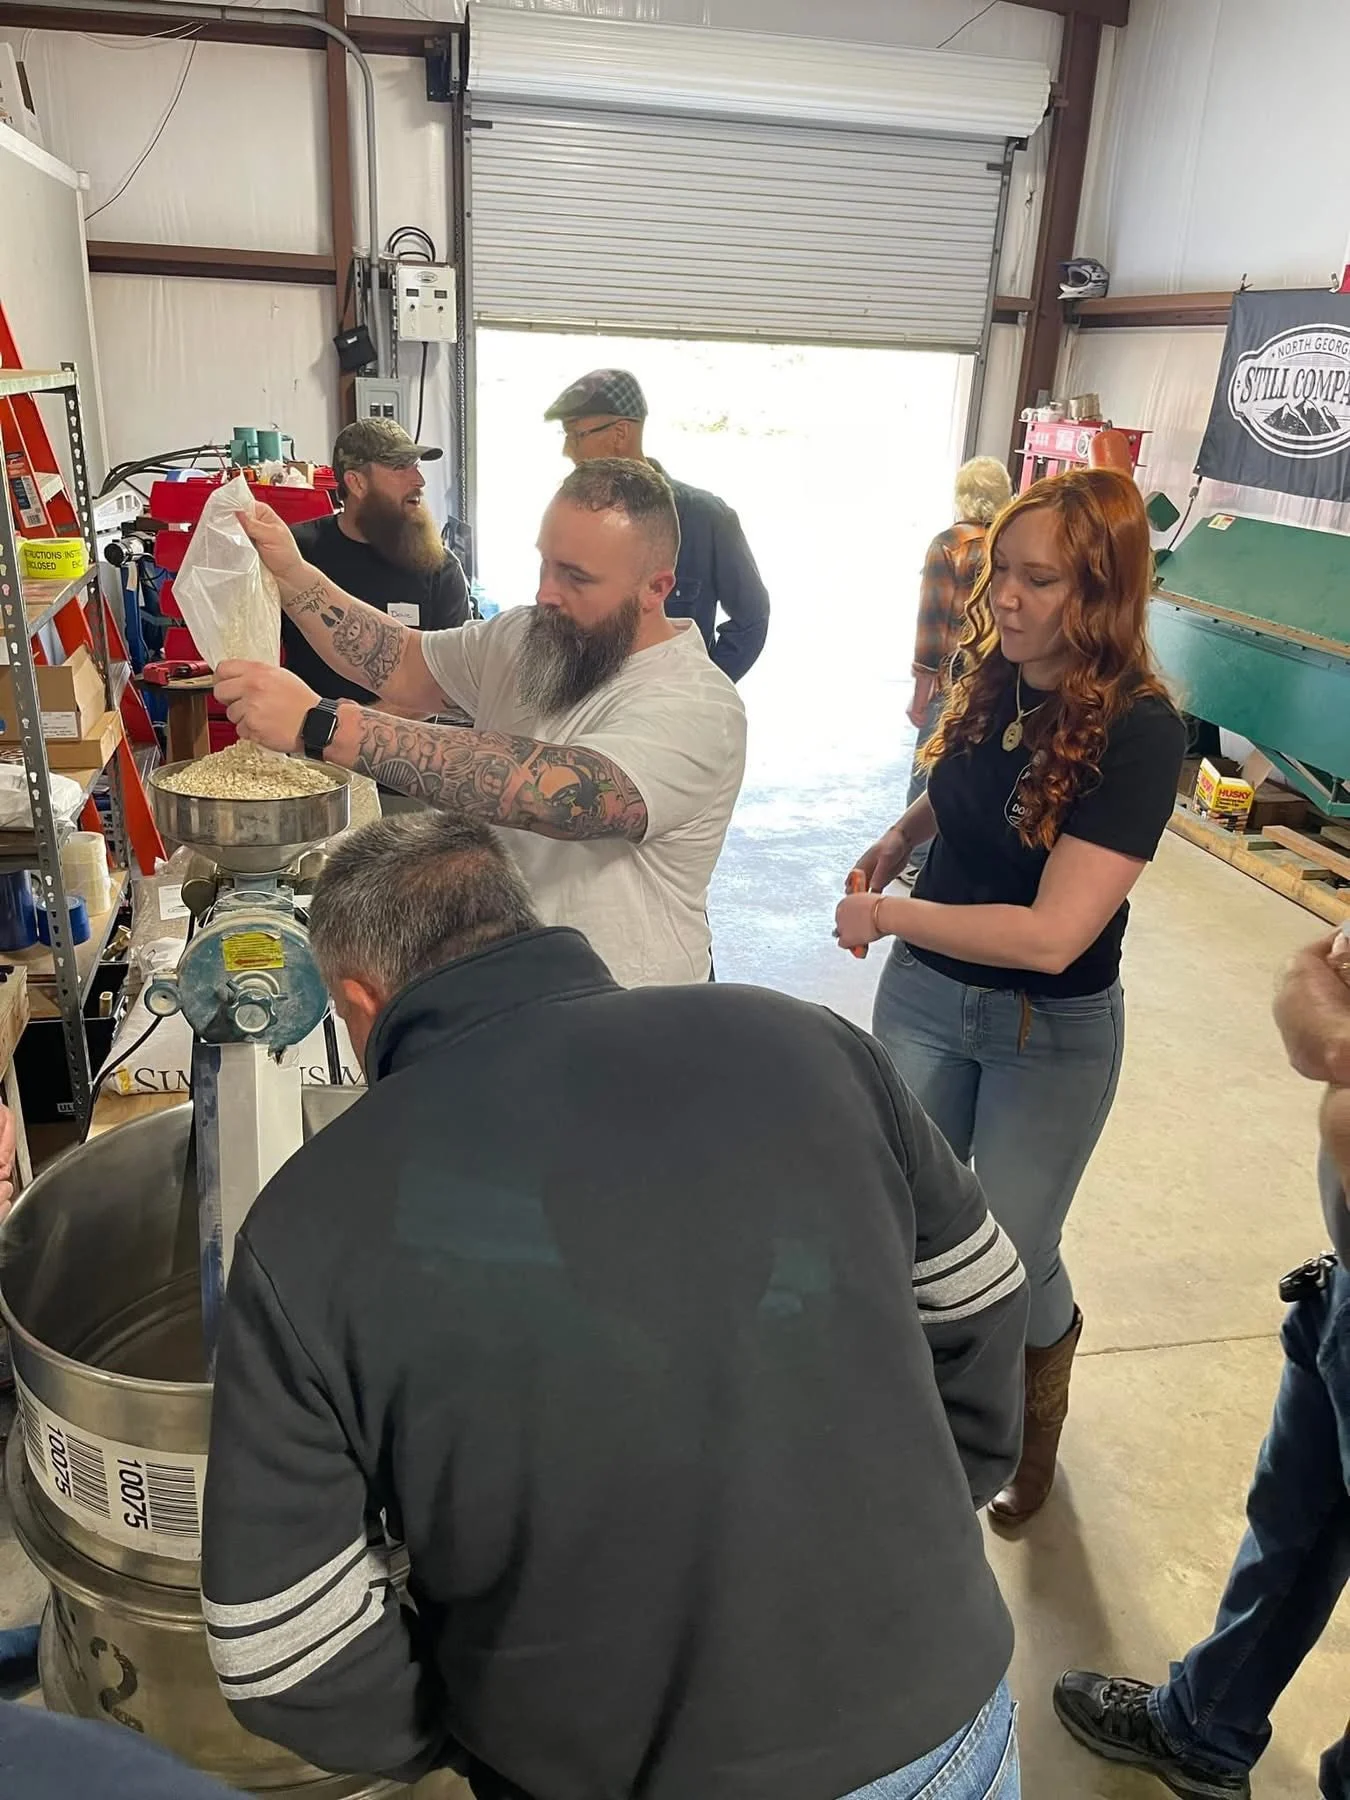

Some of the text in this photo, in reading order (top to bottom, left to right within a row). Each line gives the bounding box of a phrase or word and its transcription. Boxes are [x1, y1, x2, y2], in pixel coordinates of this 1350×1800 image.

[1278, 337, 1350, 358] NORTH GEORG
[1240, 366, 1290, 403] STILL
[1218, 788, 1251, 799] HUSKY
[47, 1423, 72, 1498] 10075
[117, 1458, 149, 1530] 10075
